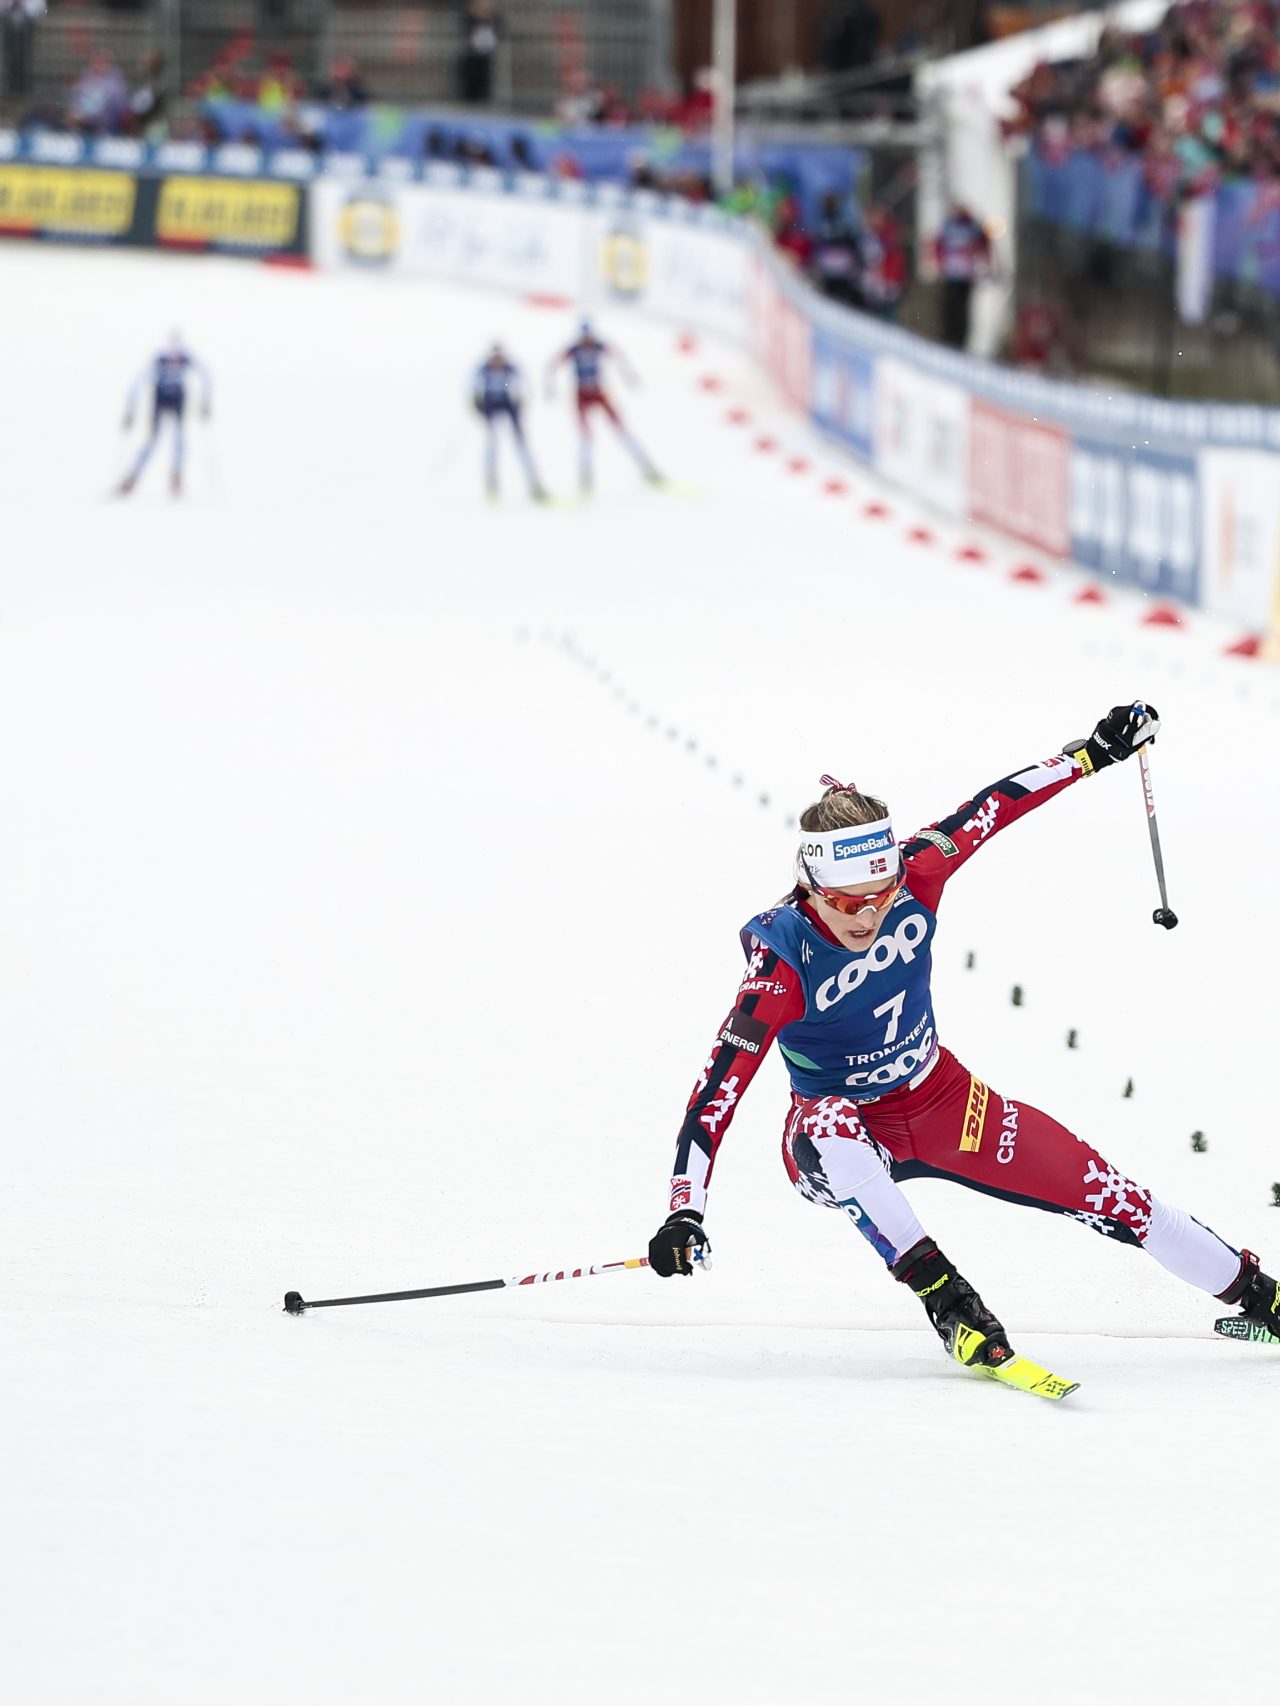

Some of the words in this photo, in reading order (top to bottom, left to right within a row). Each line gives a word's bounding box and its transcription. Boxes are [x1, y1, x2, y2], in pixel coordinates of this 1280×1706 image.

[835, 835, 888, 858] SpareBank
[815, 913, 927, 1012] coop
[720, 1029, 760, 1054] ENERGI
[873, 989, 906, 1045] 7
[846, 1027, 934, 1086] coop
[965, 1081, 986, 1140] DHL
[996, 1097, 1019, 1164] CRAF
